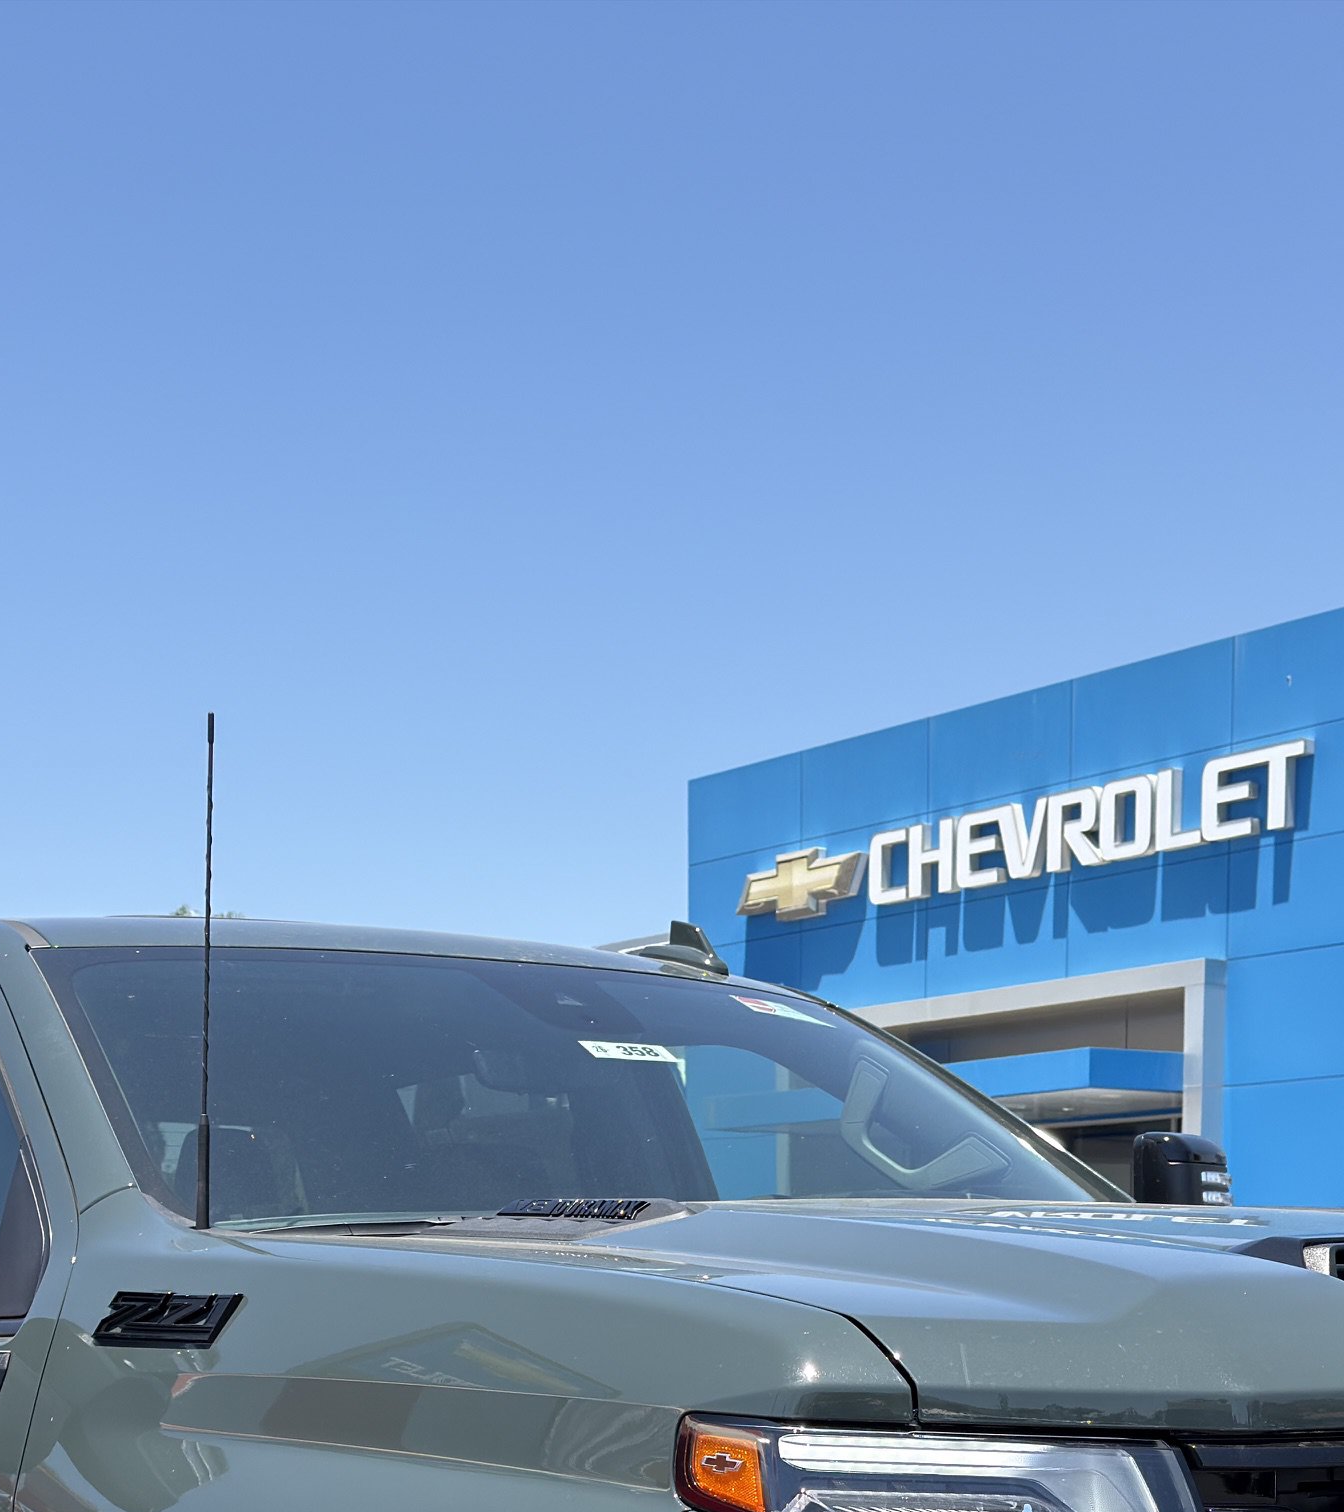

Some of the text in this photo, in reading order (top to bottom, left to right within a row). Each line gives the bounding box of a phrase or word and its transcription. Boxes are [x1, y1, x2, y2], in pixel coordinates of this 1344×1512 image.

[869, 738, 1313, 906] CHEVROLET
[616, 1044, 660, 1058] 358
[92, 1291, 244, 1349] Z71
